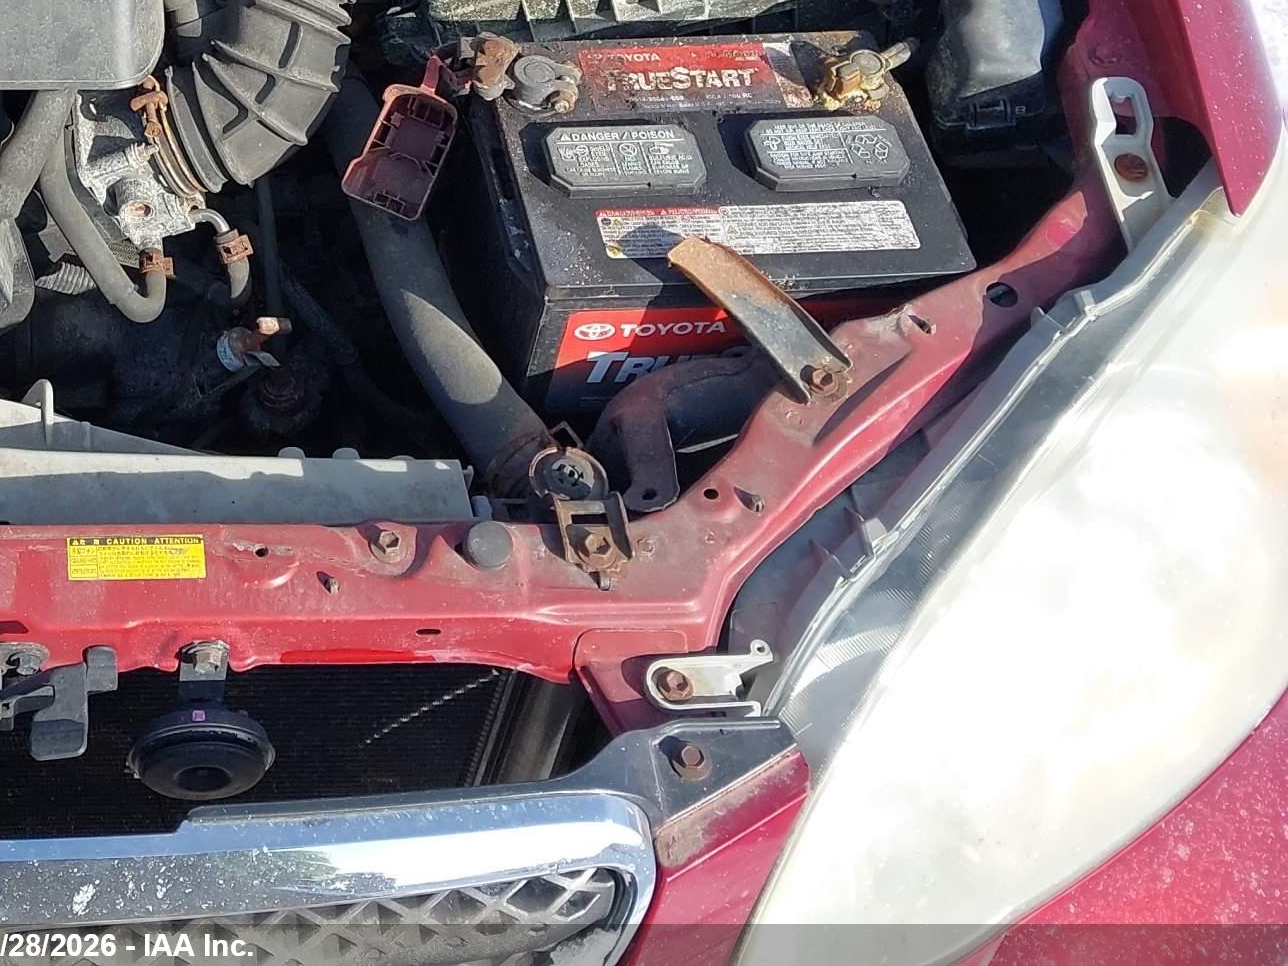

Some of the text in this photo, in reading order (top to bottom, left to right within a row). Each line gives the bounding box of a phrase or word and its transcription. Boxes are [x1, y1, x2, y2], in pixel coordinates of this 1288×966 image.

[572, 132, 620, 141] DANGER
[632, 130, 675, 139] POISON
[620, 321, 726, 338] TOYOTA
[106, 537, 148, 545] CAUTION
[154, 537, 200, 545] ATTENTION
